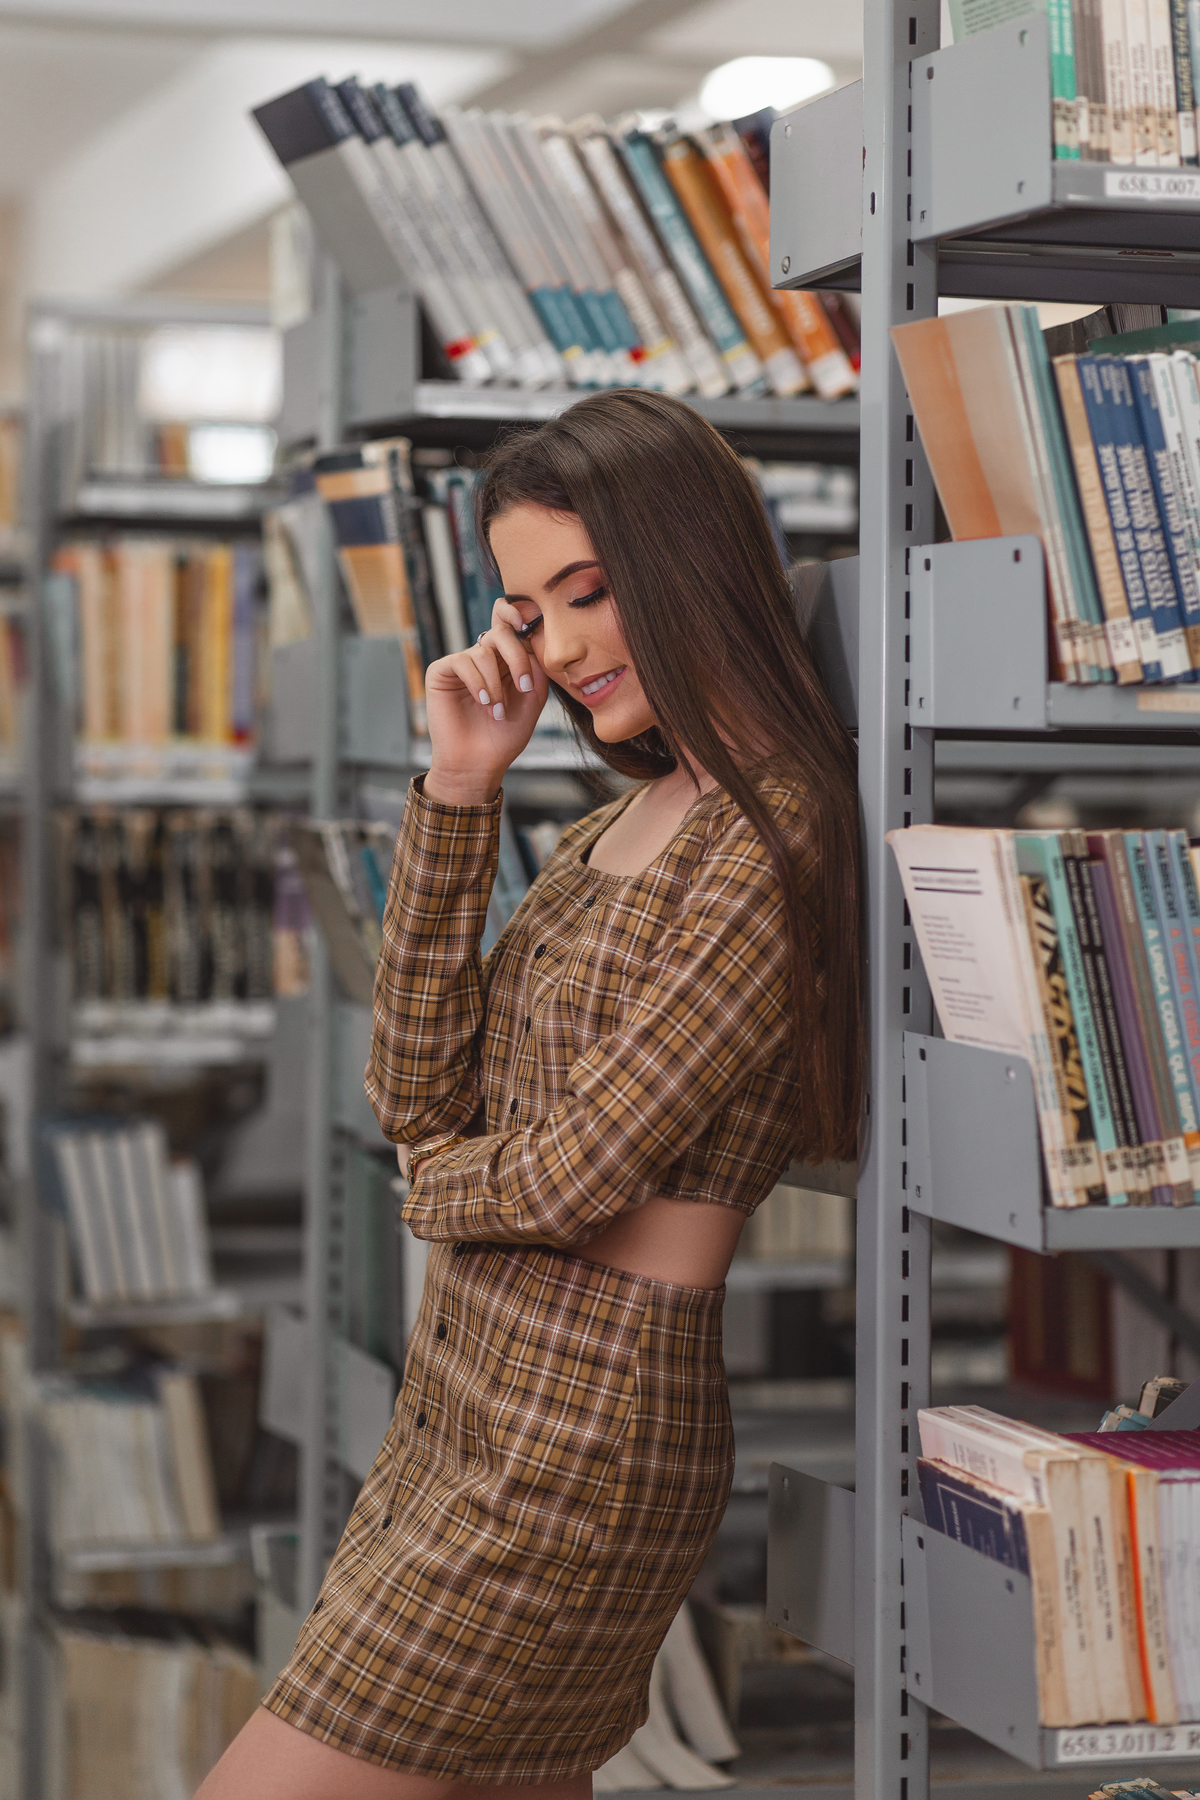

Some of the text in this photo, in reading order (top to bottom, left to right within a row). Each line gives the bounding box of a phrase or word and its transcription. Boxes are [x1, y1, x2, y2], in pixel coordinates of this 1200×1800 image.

[1098, 442, 1131, 529] QUALIDADE
[1116, 442, 1150, 529] QUALIDADE
[1154, 449, 1186, 534] QUALIDADE
[1116, 528, 1135, 551] DE
[1134, 529, 1153, 551] DE
[1171, 533, 1188, 556] DE
[1121, 550, 1147, 611] TESTES
[1140, 551, 1166, 611] TESTES
[1177, 554, 1200, 615] TESTES
[1133, 847, 1157, 920] ALBRECHT
[1155, 845, 1179, 919] ALBRECHT
[1170, 927, 1183, 939] A
[1176, 844, 1200, 918] ALBRECHT
[1147, 928, 1160, 941] A
[1160, 999, 1181, 1049] COISA
[1168, 1054, 1188, 1086] QUE
[1178, 1091, 1199, 1133] IMPO
